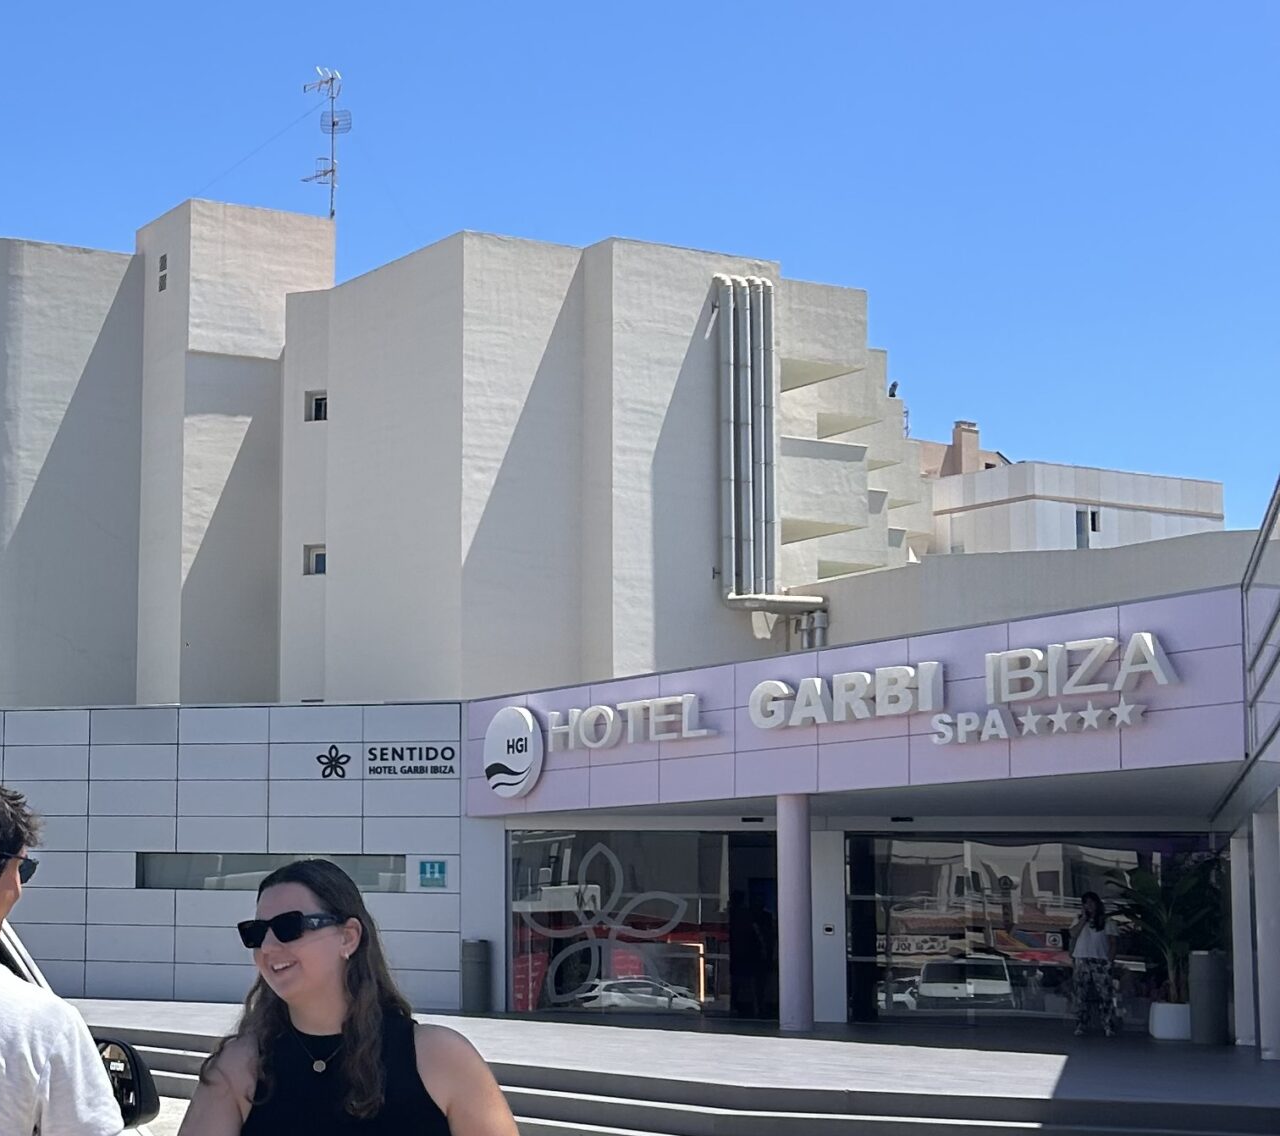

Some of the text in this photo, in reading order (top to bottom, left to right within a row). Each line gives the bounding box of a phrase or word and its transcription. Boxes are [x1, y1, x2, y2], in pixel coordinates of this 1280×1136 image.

[548, 631, 1177, 752] HOTEL GARBI IBIZA
[930, 707, 1014, 746] SPA
[367, 746, 456, 762] SENTIDO
[506, 736, 528, 755] HGI
[368, 765, 455, 775] HOTEL GARBI IBIZA
